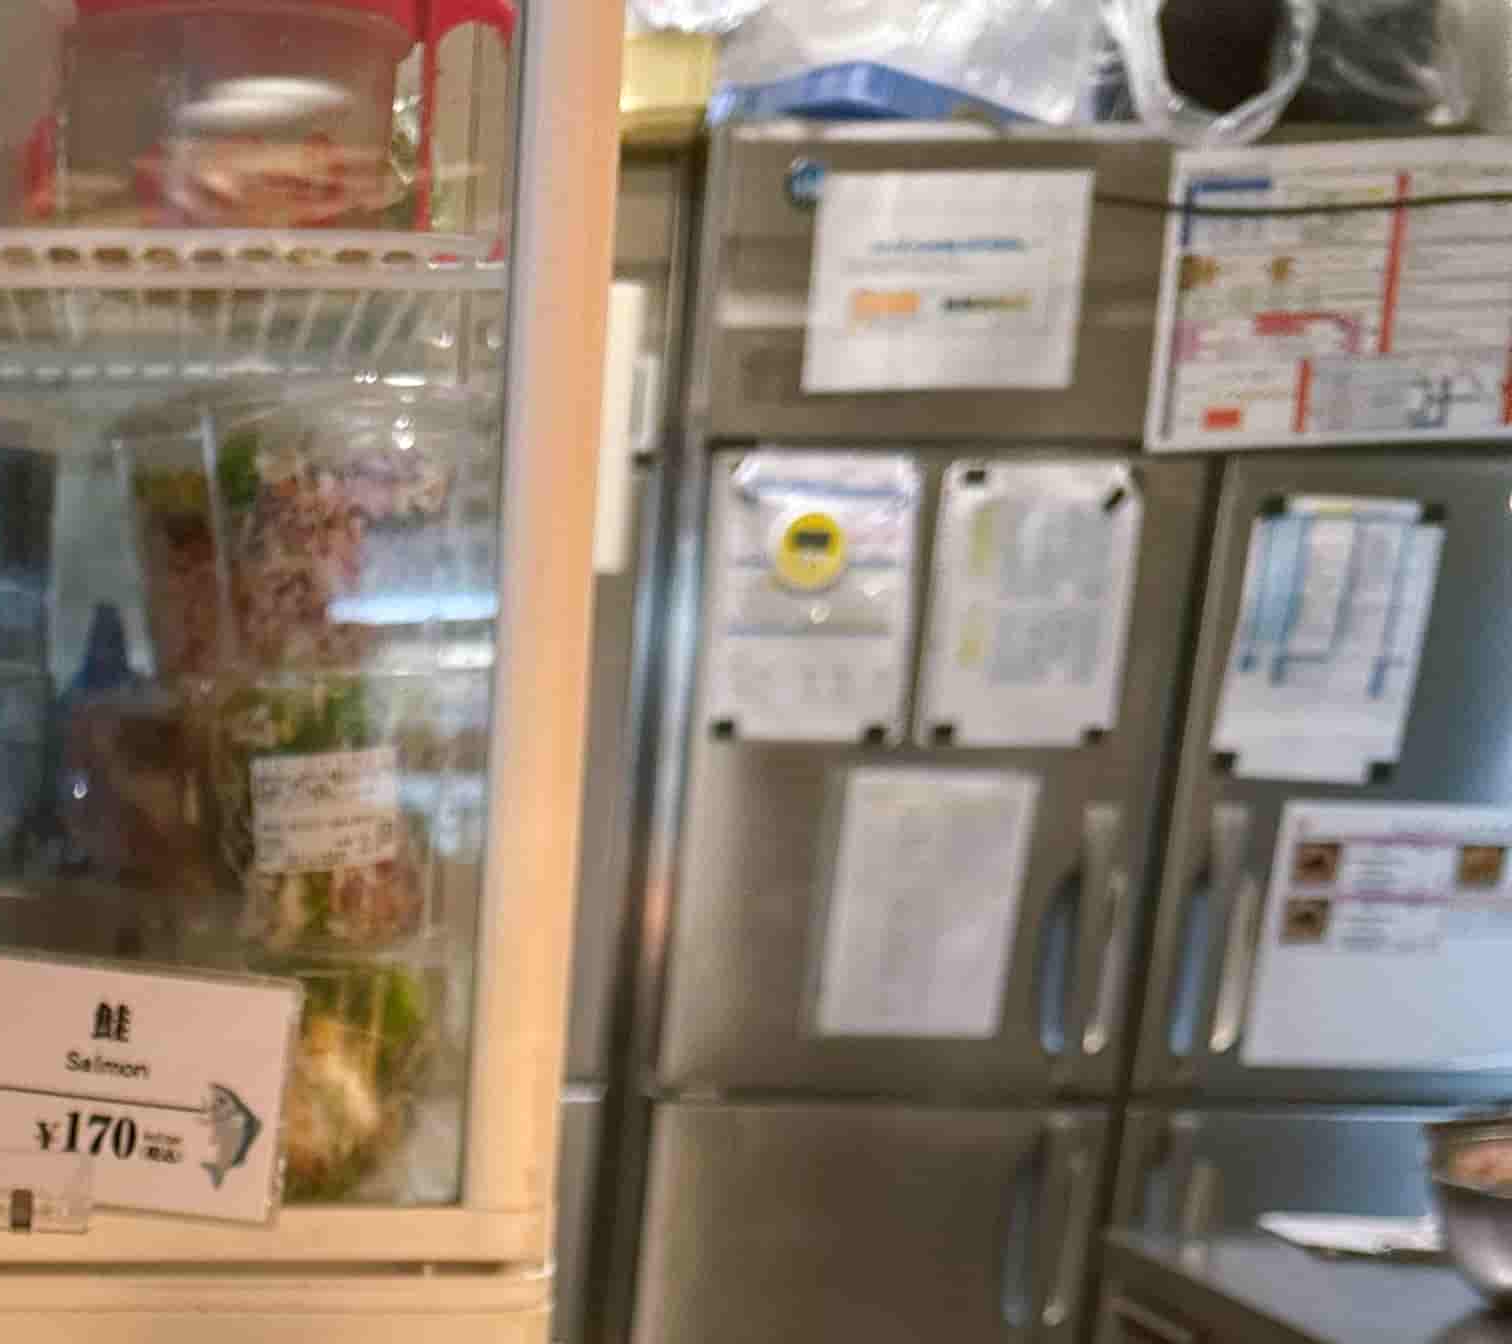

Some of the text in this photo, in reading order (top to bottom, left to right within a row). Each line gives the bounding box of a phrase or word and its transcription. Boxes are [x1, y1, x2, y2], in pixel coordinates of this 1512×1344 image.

[91, 1001, 132, 1043] 鮭
[65, 1050, 151, 1080] Salmon
[33, 1110, 138, 1159] ¥170
